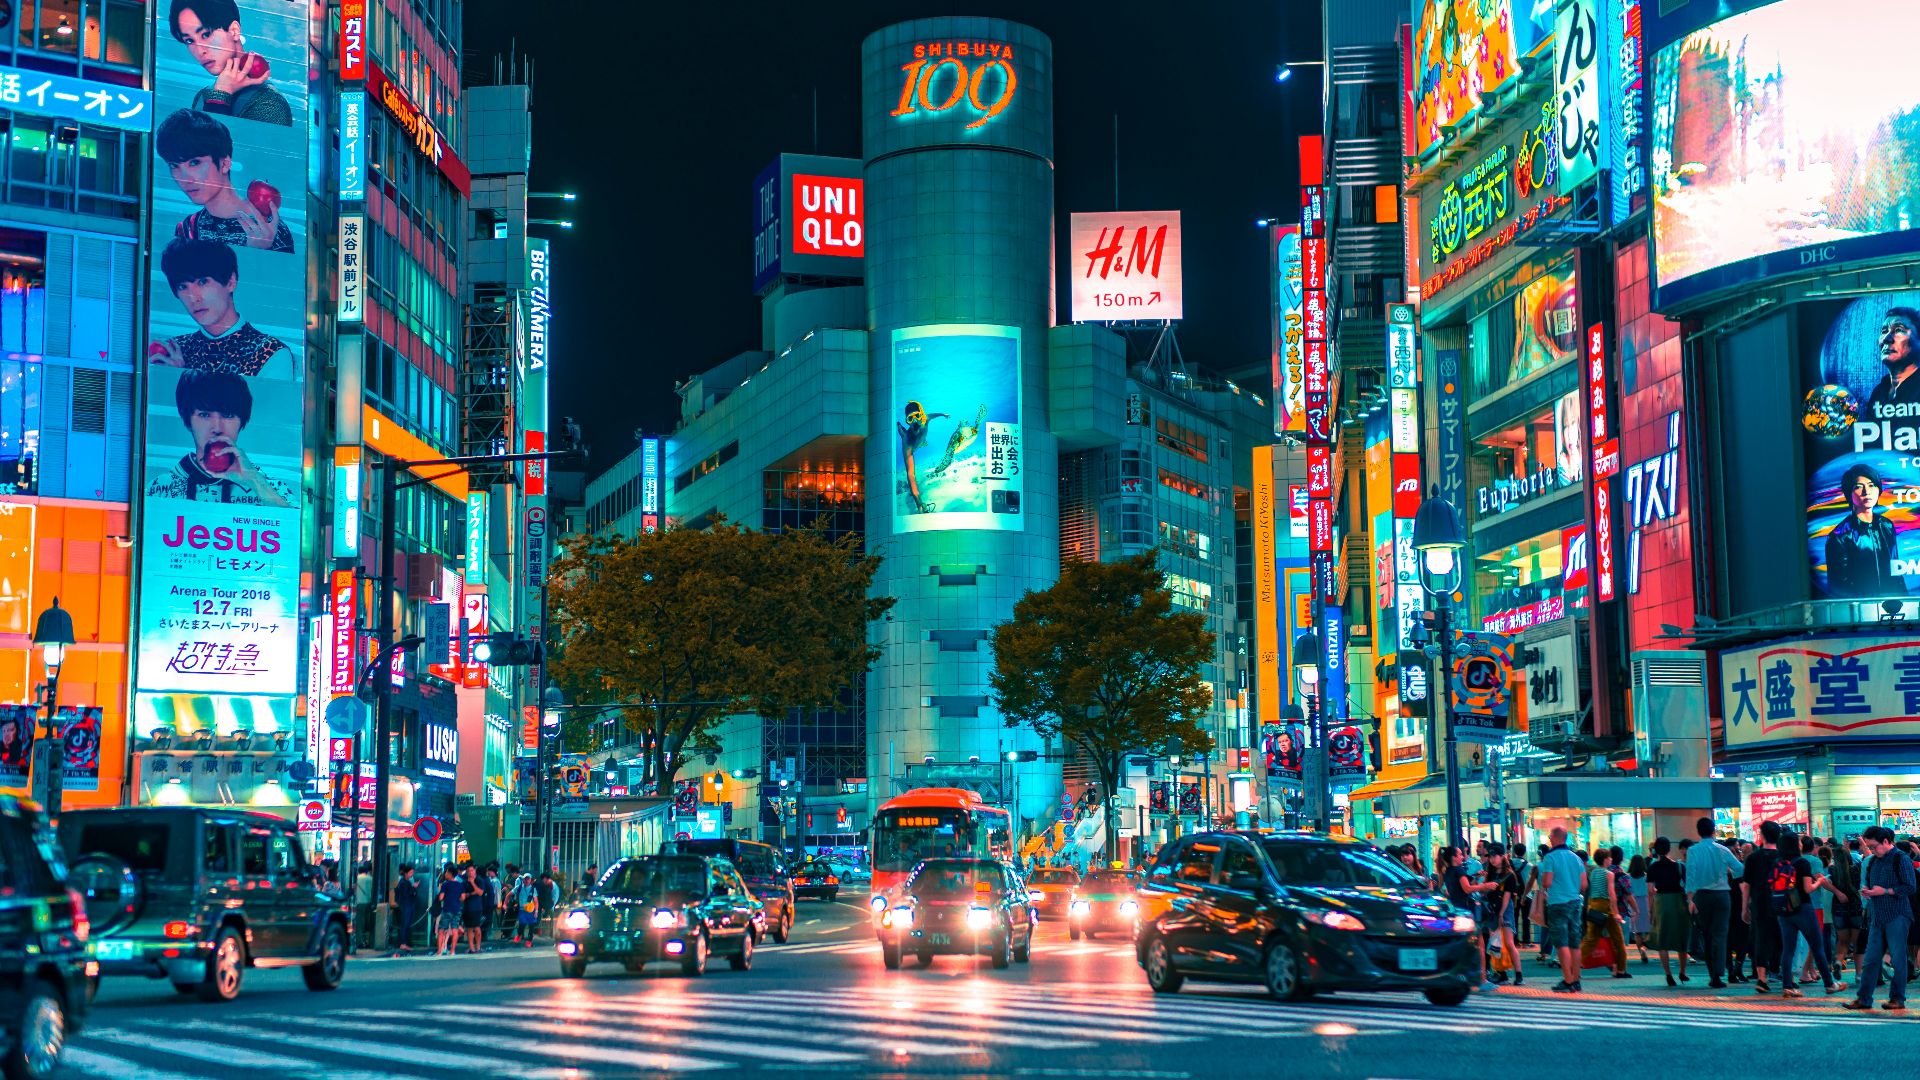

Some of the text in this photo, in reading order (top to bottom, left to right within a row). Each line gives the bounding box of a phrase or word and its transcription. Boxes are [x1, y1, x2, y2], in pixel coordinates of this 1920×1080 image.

[345, 18, 362, 69] ガスト
[914, 42, 1013, 59] SHIBUYA
[889, 57, 1017, 129] 109
[345, 103, 359, 189] 英会話イーオン
[416, 115, 443, 167] ガスト
[760, 177, 775, 228] THE
[802, 184, 856, 216] UNI
[754, 218, 779, 278] PRIME
[802, 217, 862, 250] QLO
[1084, 225, 1168, 280] H&M
[343, 222, 358, 313] 渋谷駅前ビル
[1800, 246, 1836, 265] DHC
[530, 249, 552, 370] BIC CAMERA
[1312, 395, 1322, 403] 6F
[1401, 392, 1411, 442] Euphoria
[990, 434, 1019, 446] 世界に
[1853, 420, 1920, 453] Pla
[1479, 462, 1554, 514] Euphoria
[1626, 449, 1679, 528] クスリ
[163, 515, 281, 554] Jesus
[232, 517, 281, 527] NEW SINGLE
[527, 507, 546, 537] OS
[529, 538, 542, 588] 調剤薬局
[1261, 531, 1271, 603] Matsumoto
[1400, 536, 1408, 569] パーラー
[170, 585, 271, 600] Arena Tour 2018
[192, 600, 252, 617] 12.7 FRI
[159, 617, 280, 633] さいたまスーパーアリーナ
[435, 608, 446, 660] 渋谷駅前
[1402, 602, 1411, 635] フルーツ
[336, 605, 352, 684] サンドラッグ
[1327, 619, 1339, 669] MIZUHO
[1466, 716, 1494, 727] Tik Tok
[426, 723, 458, 765] LUSH
[1740, 763, 1769, 771] TAISEIDO
